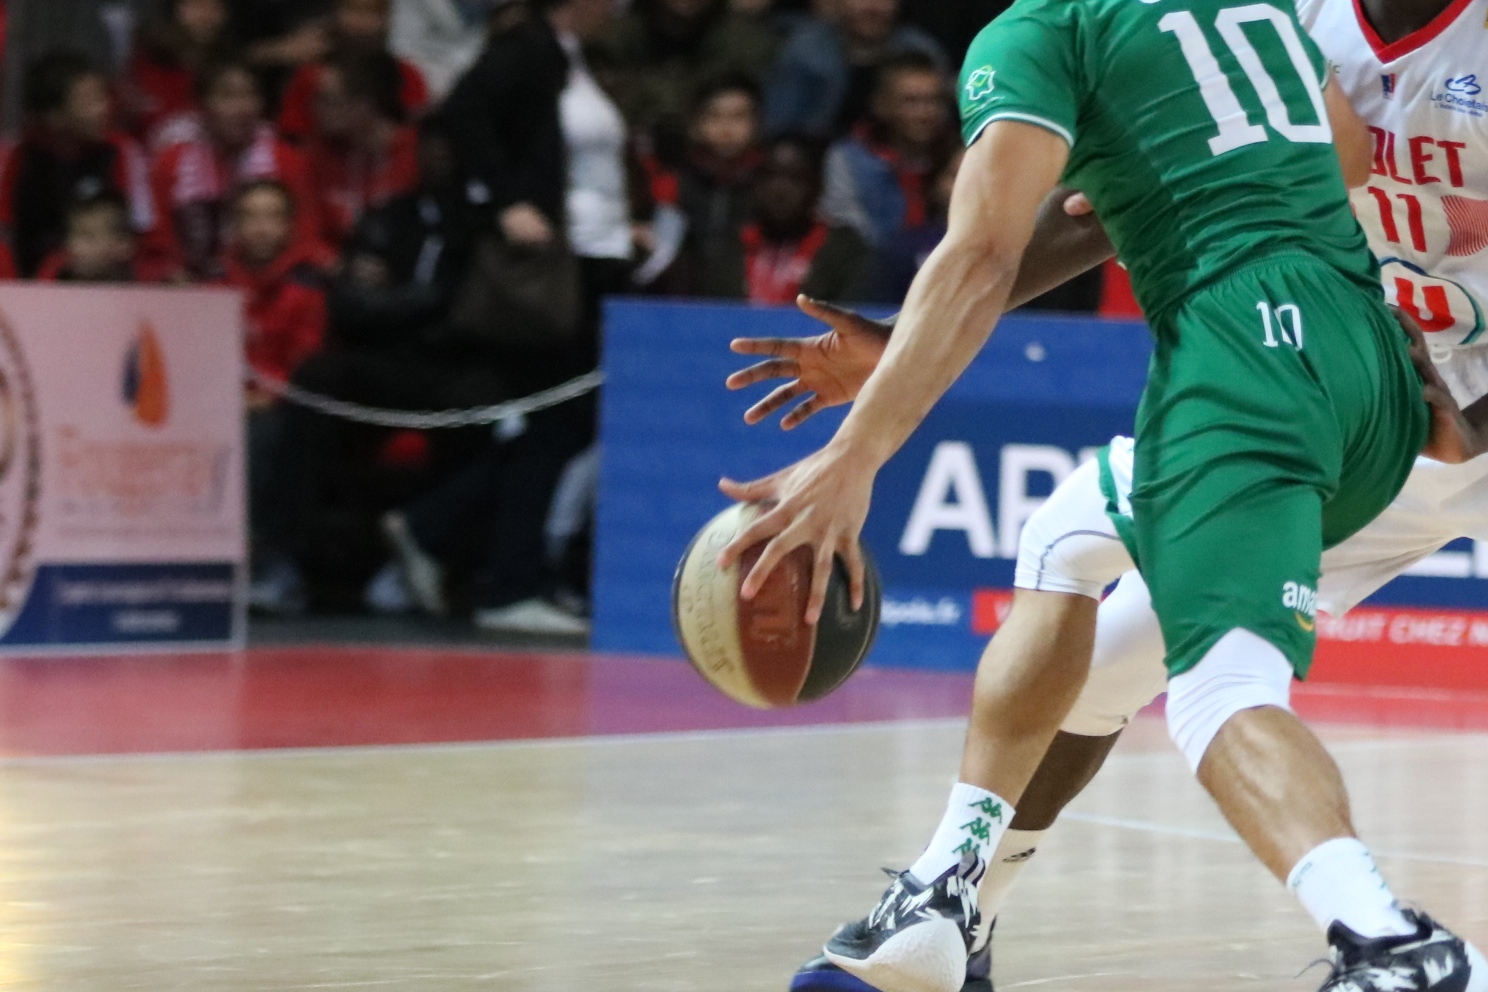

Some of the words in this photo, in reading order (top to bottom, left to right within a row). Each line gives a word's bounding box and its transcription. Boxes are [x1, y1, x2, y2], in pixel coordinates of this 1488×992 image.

[1157, 3, 1333, 157] 10
[1367, 185, 1427, 253] 11
[1256, 301, 1303, 352] 10
[1388, 614, 1468, 647] CHEZ
